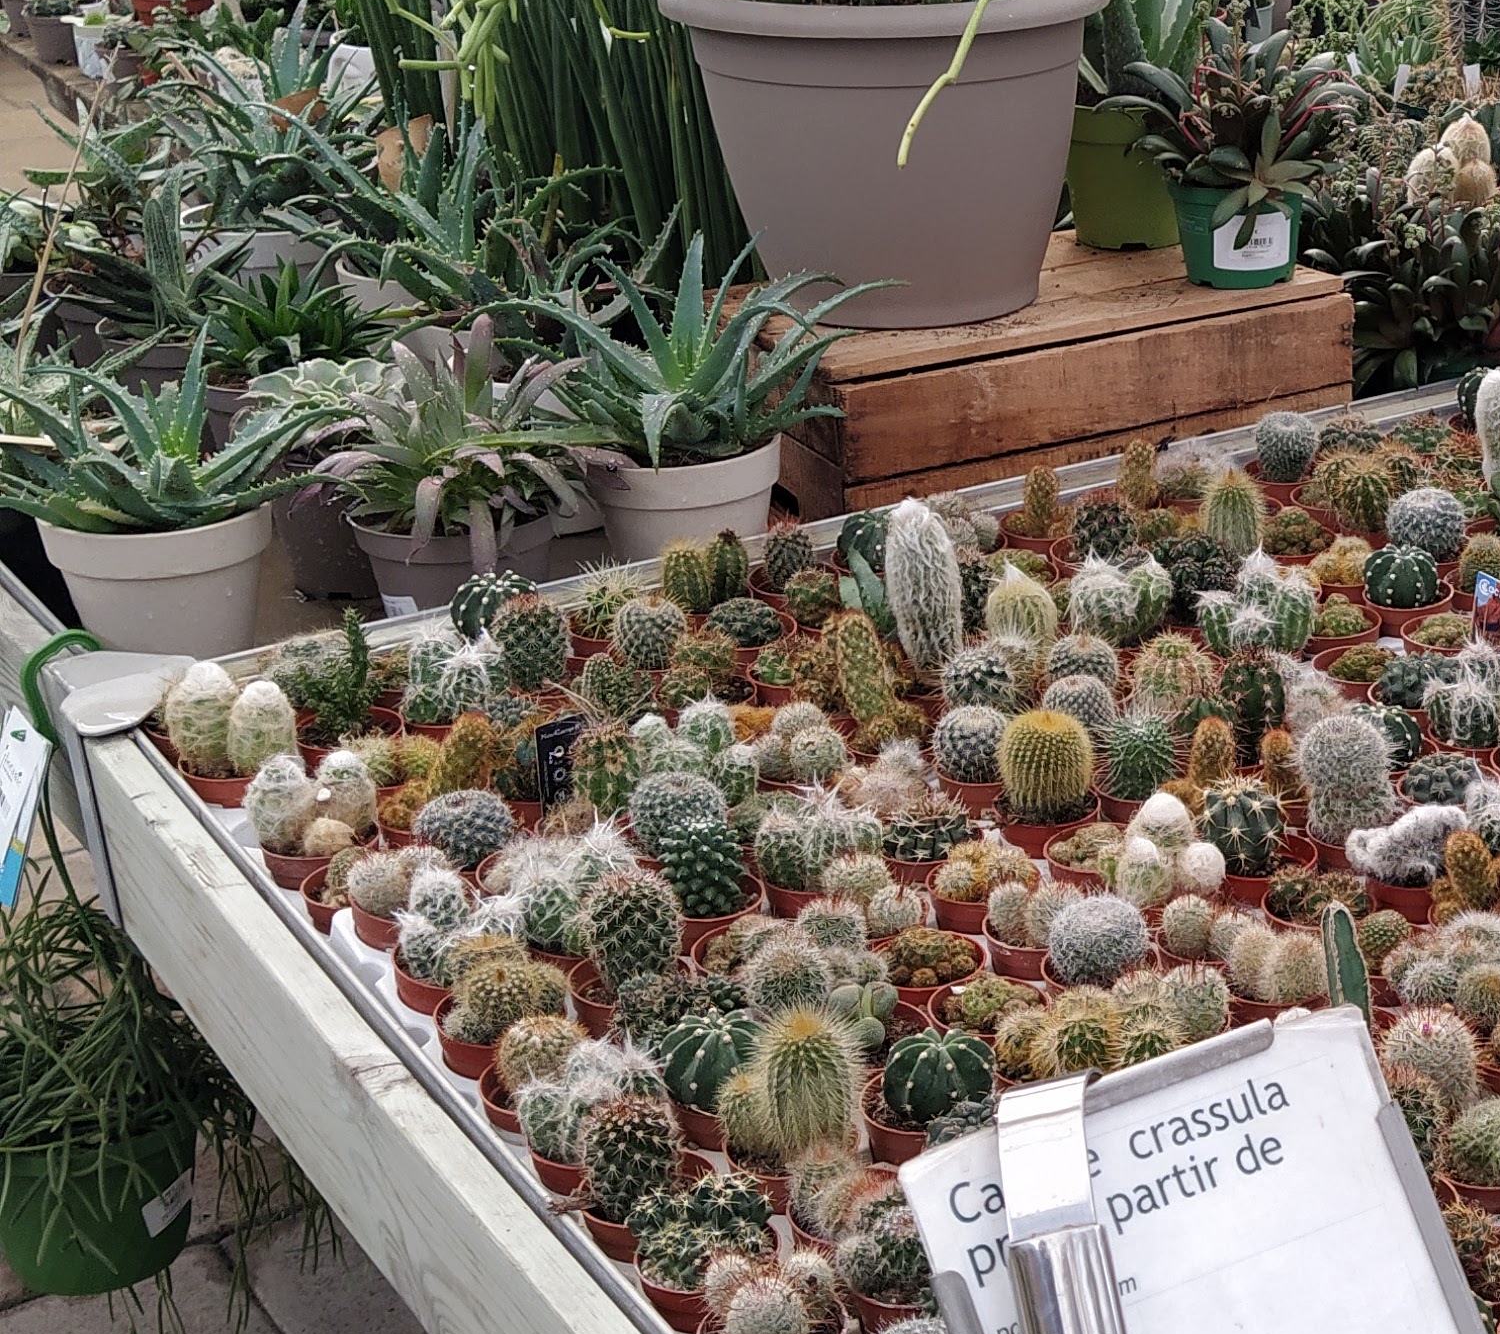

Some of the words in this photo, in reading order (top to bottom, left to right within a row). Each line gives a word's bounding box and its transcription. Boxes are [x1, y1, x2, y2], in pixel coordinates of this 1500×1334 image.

[1129, 1078, 1291, 1159] crassula
[1106, 1154, 1219, 1235] partir
[1236, 1133, 1285, 1175] de
